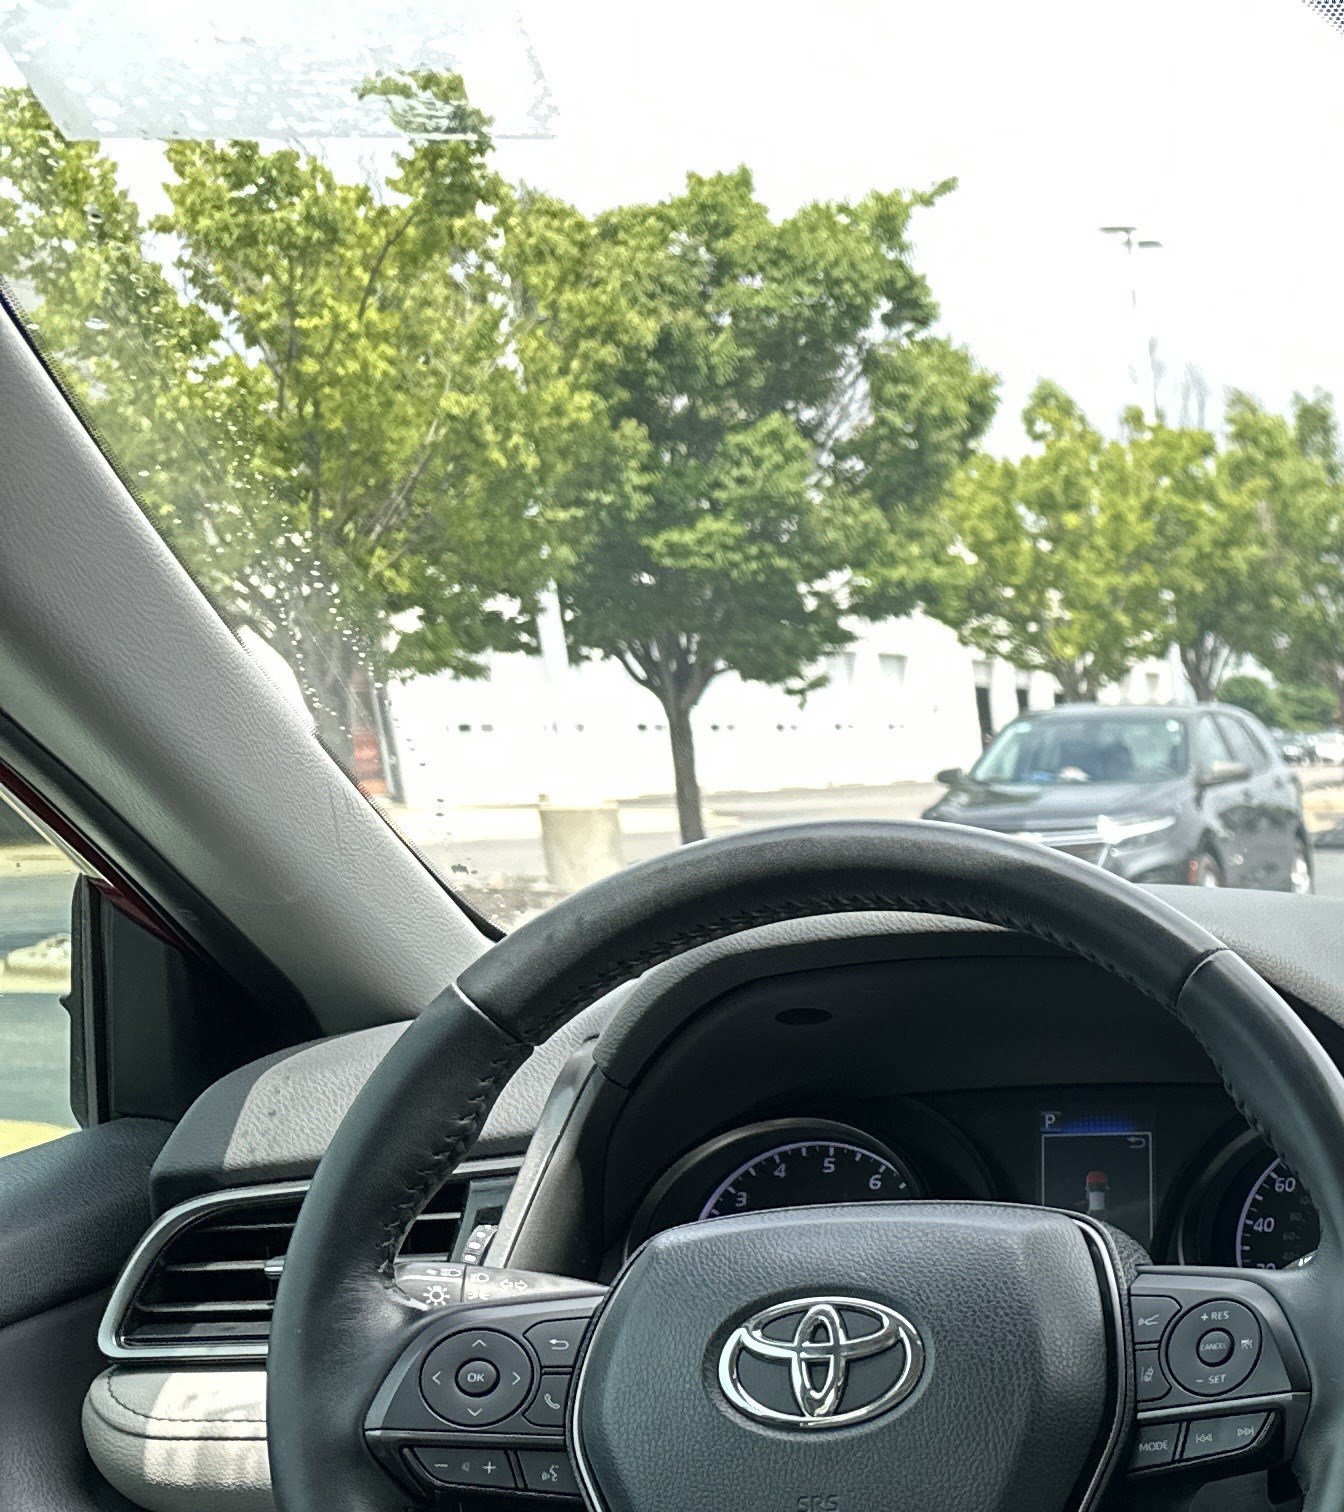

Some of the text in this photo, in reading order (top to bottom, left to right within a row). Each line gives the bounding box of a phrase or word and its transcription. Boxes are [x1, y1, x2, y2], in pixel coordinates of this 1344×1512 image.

[1045, 1113, 1056, 1129] P
[773, 1163, 787, 1178] 4
[822, 1157, 836, 1173] 5
[869, 1174, 882, 1190] 6
[1274, 1177, 1296, 1193] 60
[735, 1191, 748, 1207] 3
[1253, 1217, 1275, 1233] 40
[1211, 1310, 1230, 1321] RES
[467, 1372, 485, 1383] OK
[1208, 1374, 1226, 1385] SET
[1138, 1439, 1169, 1452] MODE
